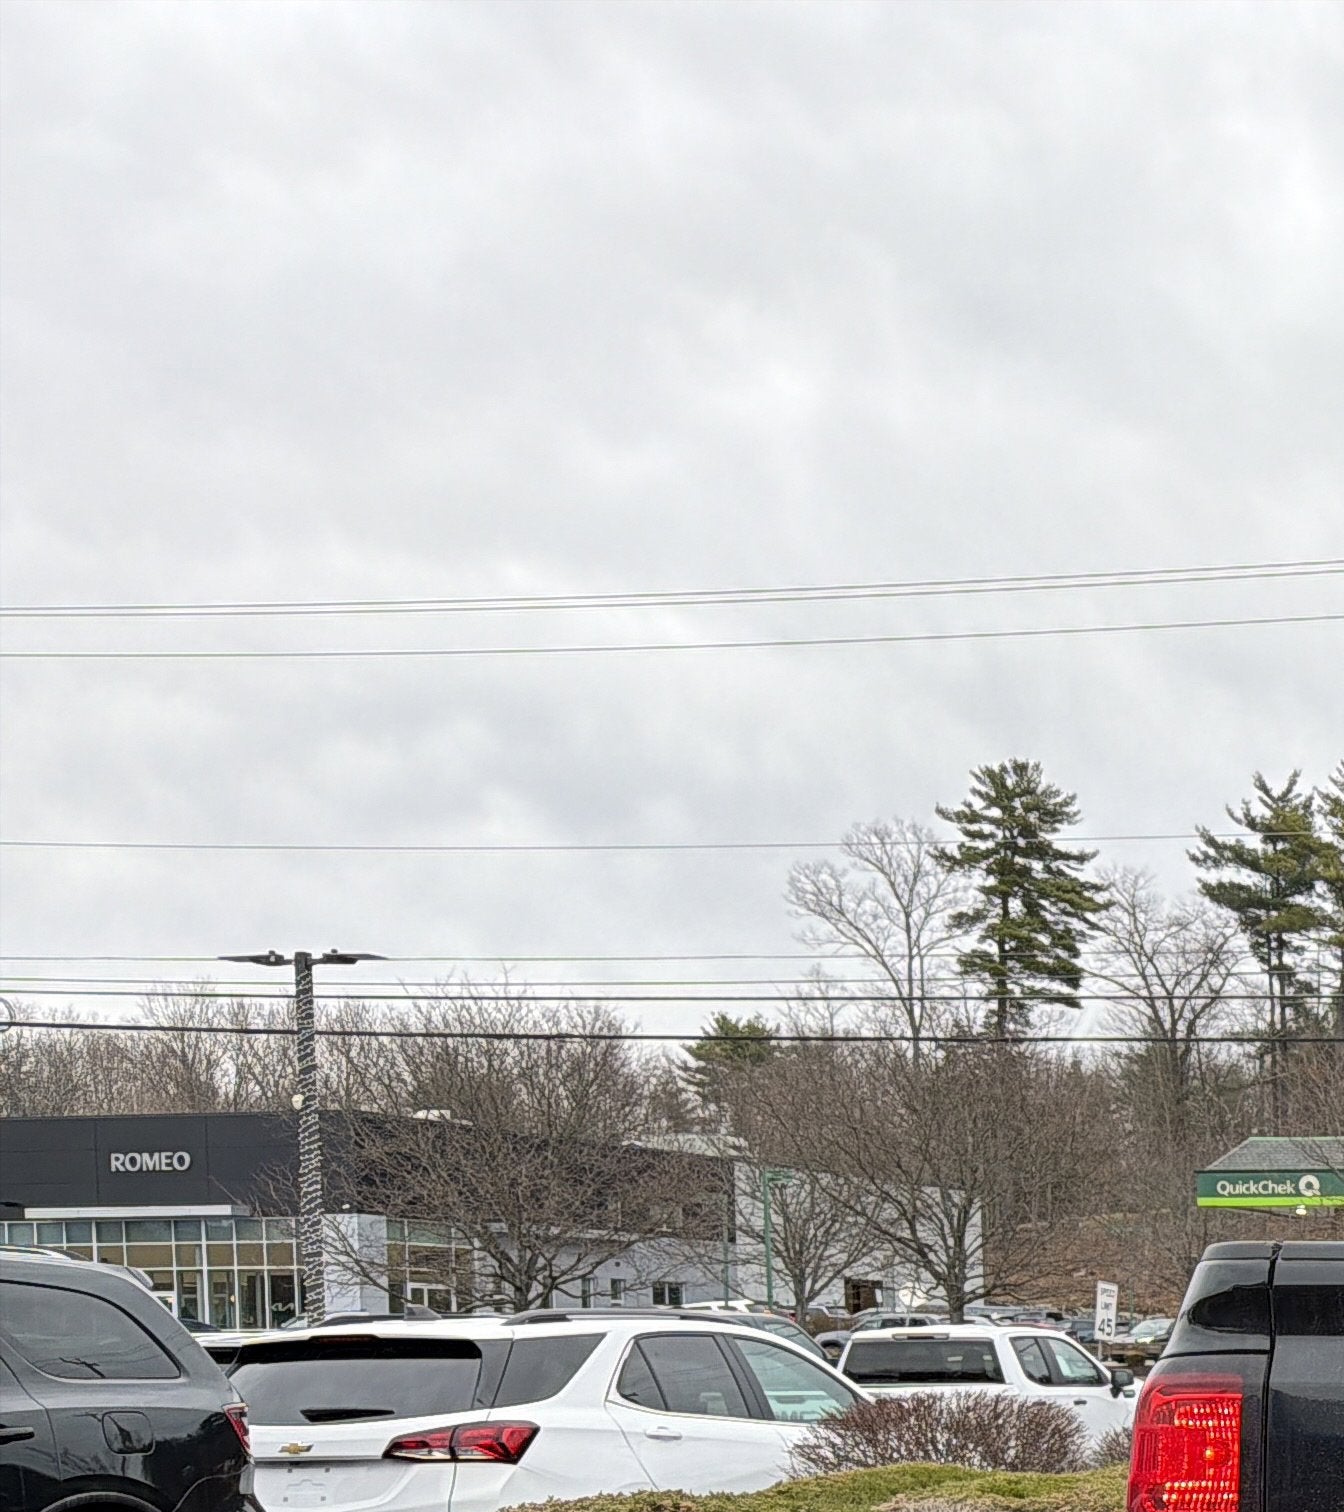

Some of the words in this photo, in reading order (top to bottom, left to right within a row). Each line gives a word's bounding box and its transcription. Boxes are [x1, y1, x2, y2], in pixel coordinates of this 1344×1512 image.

[110, 1151, 191, 1172] ROMEO
[1216, 1180, 1296, 1196] QuickChek
[1097, 1318, 1113, 1337] 45
